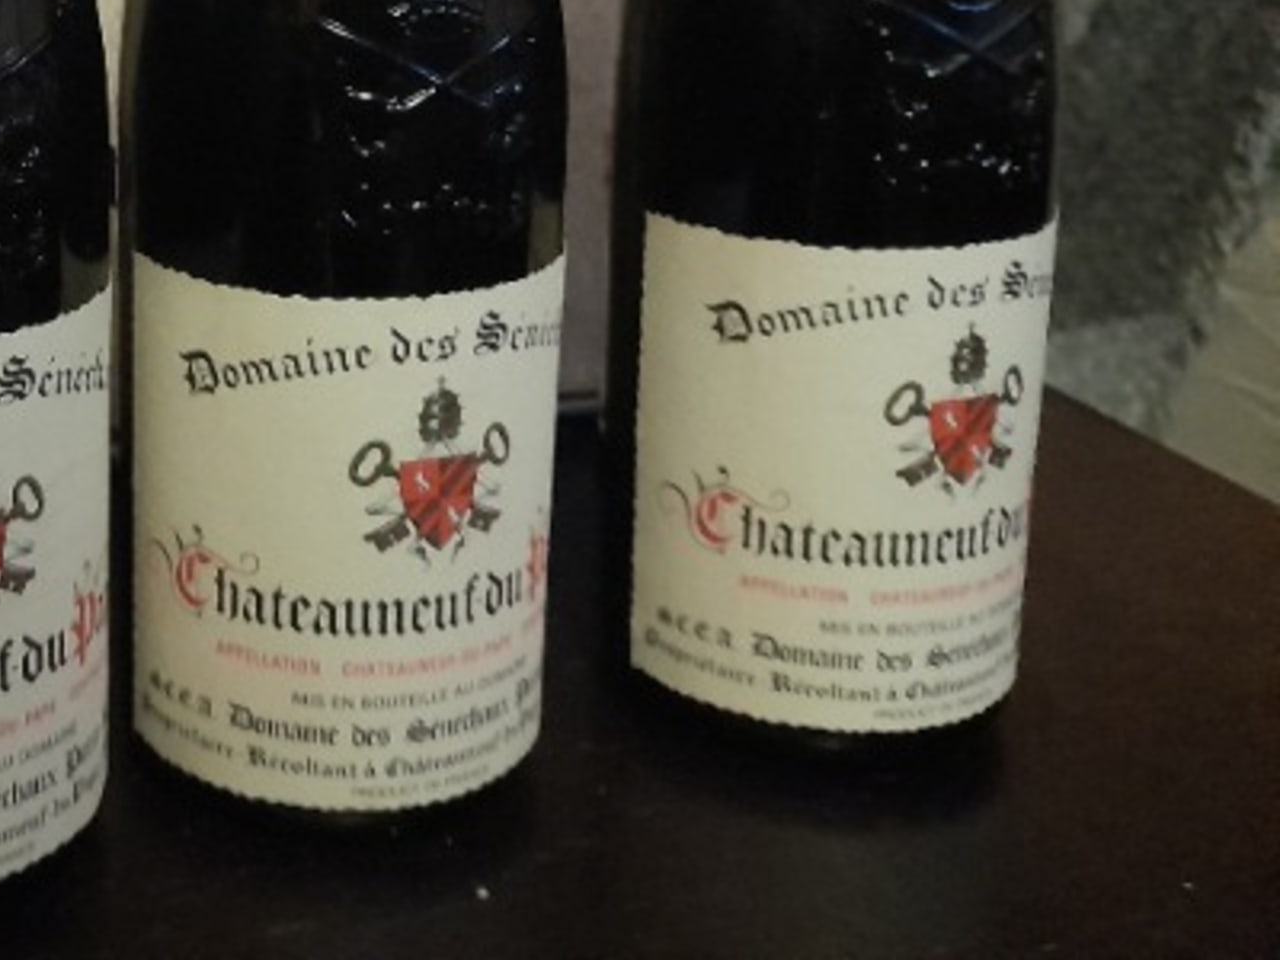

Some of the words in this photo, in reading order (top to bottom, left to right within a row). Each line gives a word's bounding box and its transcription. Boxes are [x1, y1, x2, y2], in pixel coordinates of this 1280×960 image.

[706, 284, 910, 343] Domaine
[927, 275, 990, 310] des
[178, 338, 373, 396] Domaine
[389, 326, 461, 365] des
